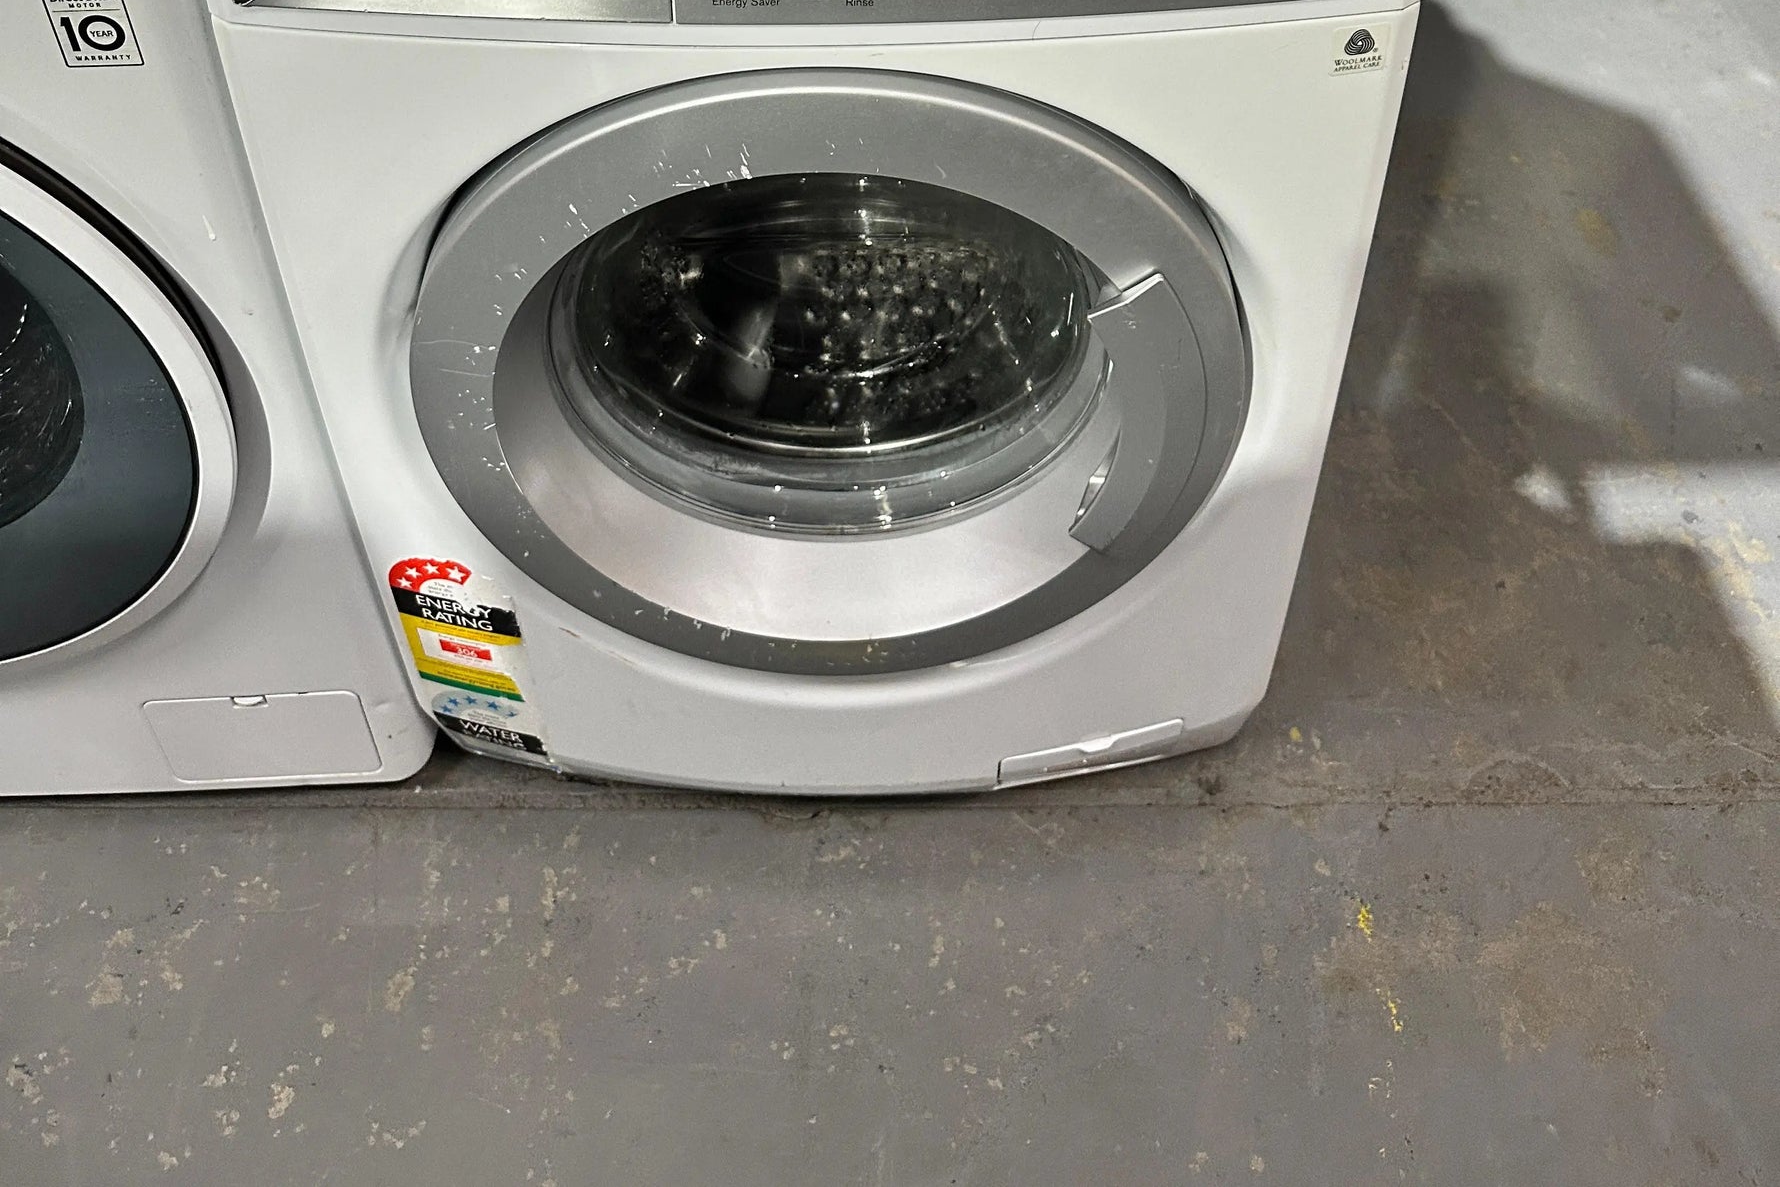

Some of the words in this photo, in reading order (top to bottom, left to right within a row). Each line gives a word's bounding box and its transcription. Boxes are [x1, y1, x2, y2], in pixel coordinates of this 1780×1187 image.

[60, 15, 126, 52] 10
[1333, 64, 1362, 72] APPAREL
[1363, 61, 1380, 69] CARE
[1334, 55, 1382, 66] WOOLMARK
[415, 594, 491, 618] ENERGY
[421, 608, 493, 631] RATING
[460, 719, 523, 743] WATER
